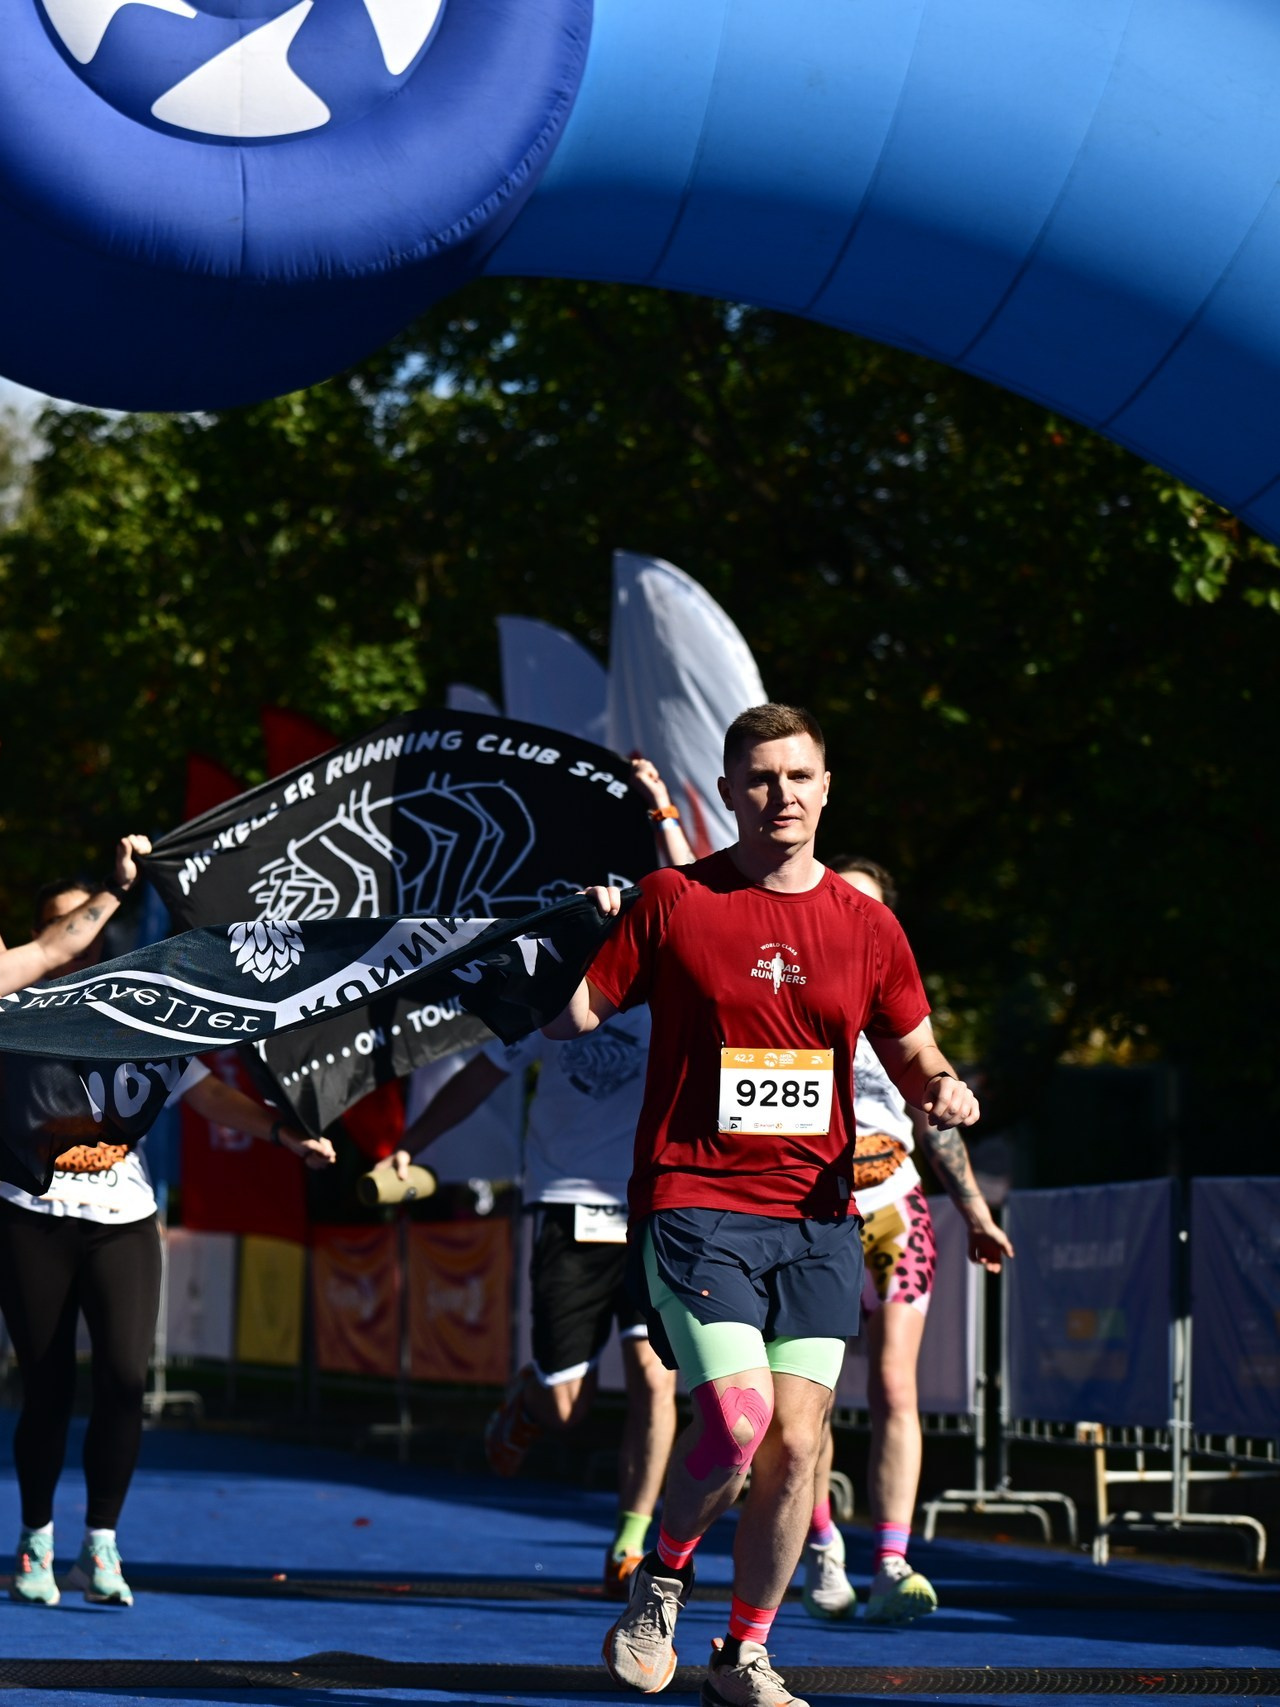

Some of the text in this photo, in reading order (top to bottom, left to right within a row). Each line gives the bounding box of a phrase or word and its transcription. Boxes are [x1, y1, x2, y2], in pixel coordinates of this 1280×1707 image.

[325, 730, 464, 786] RUNNING
[476, 734, 561, 765] CLUB
[568, 760, 629, 800] SPB
[760, 942, 798, 957] WORLD CLASS
[736, 1079, 820, 1108] 9285
